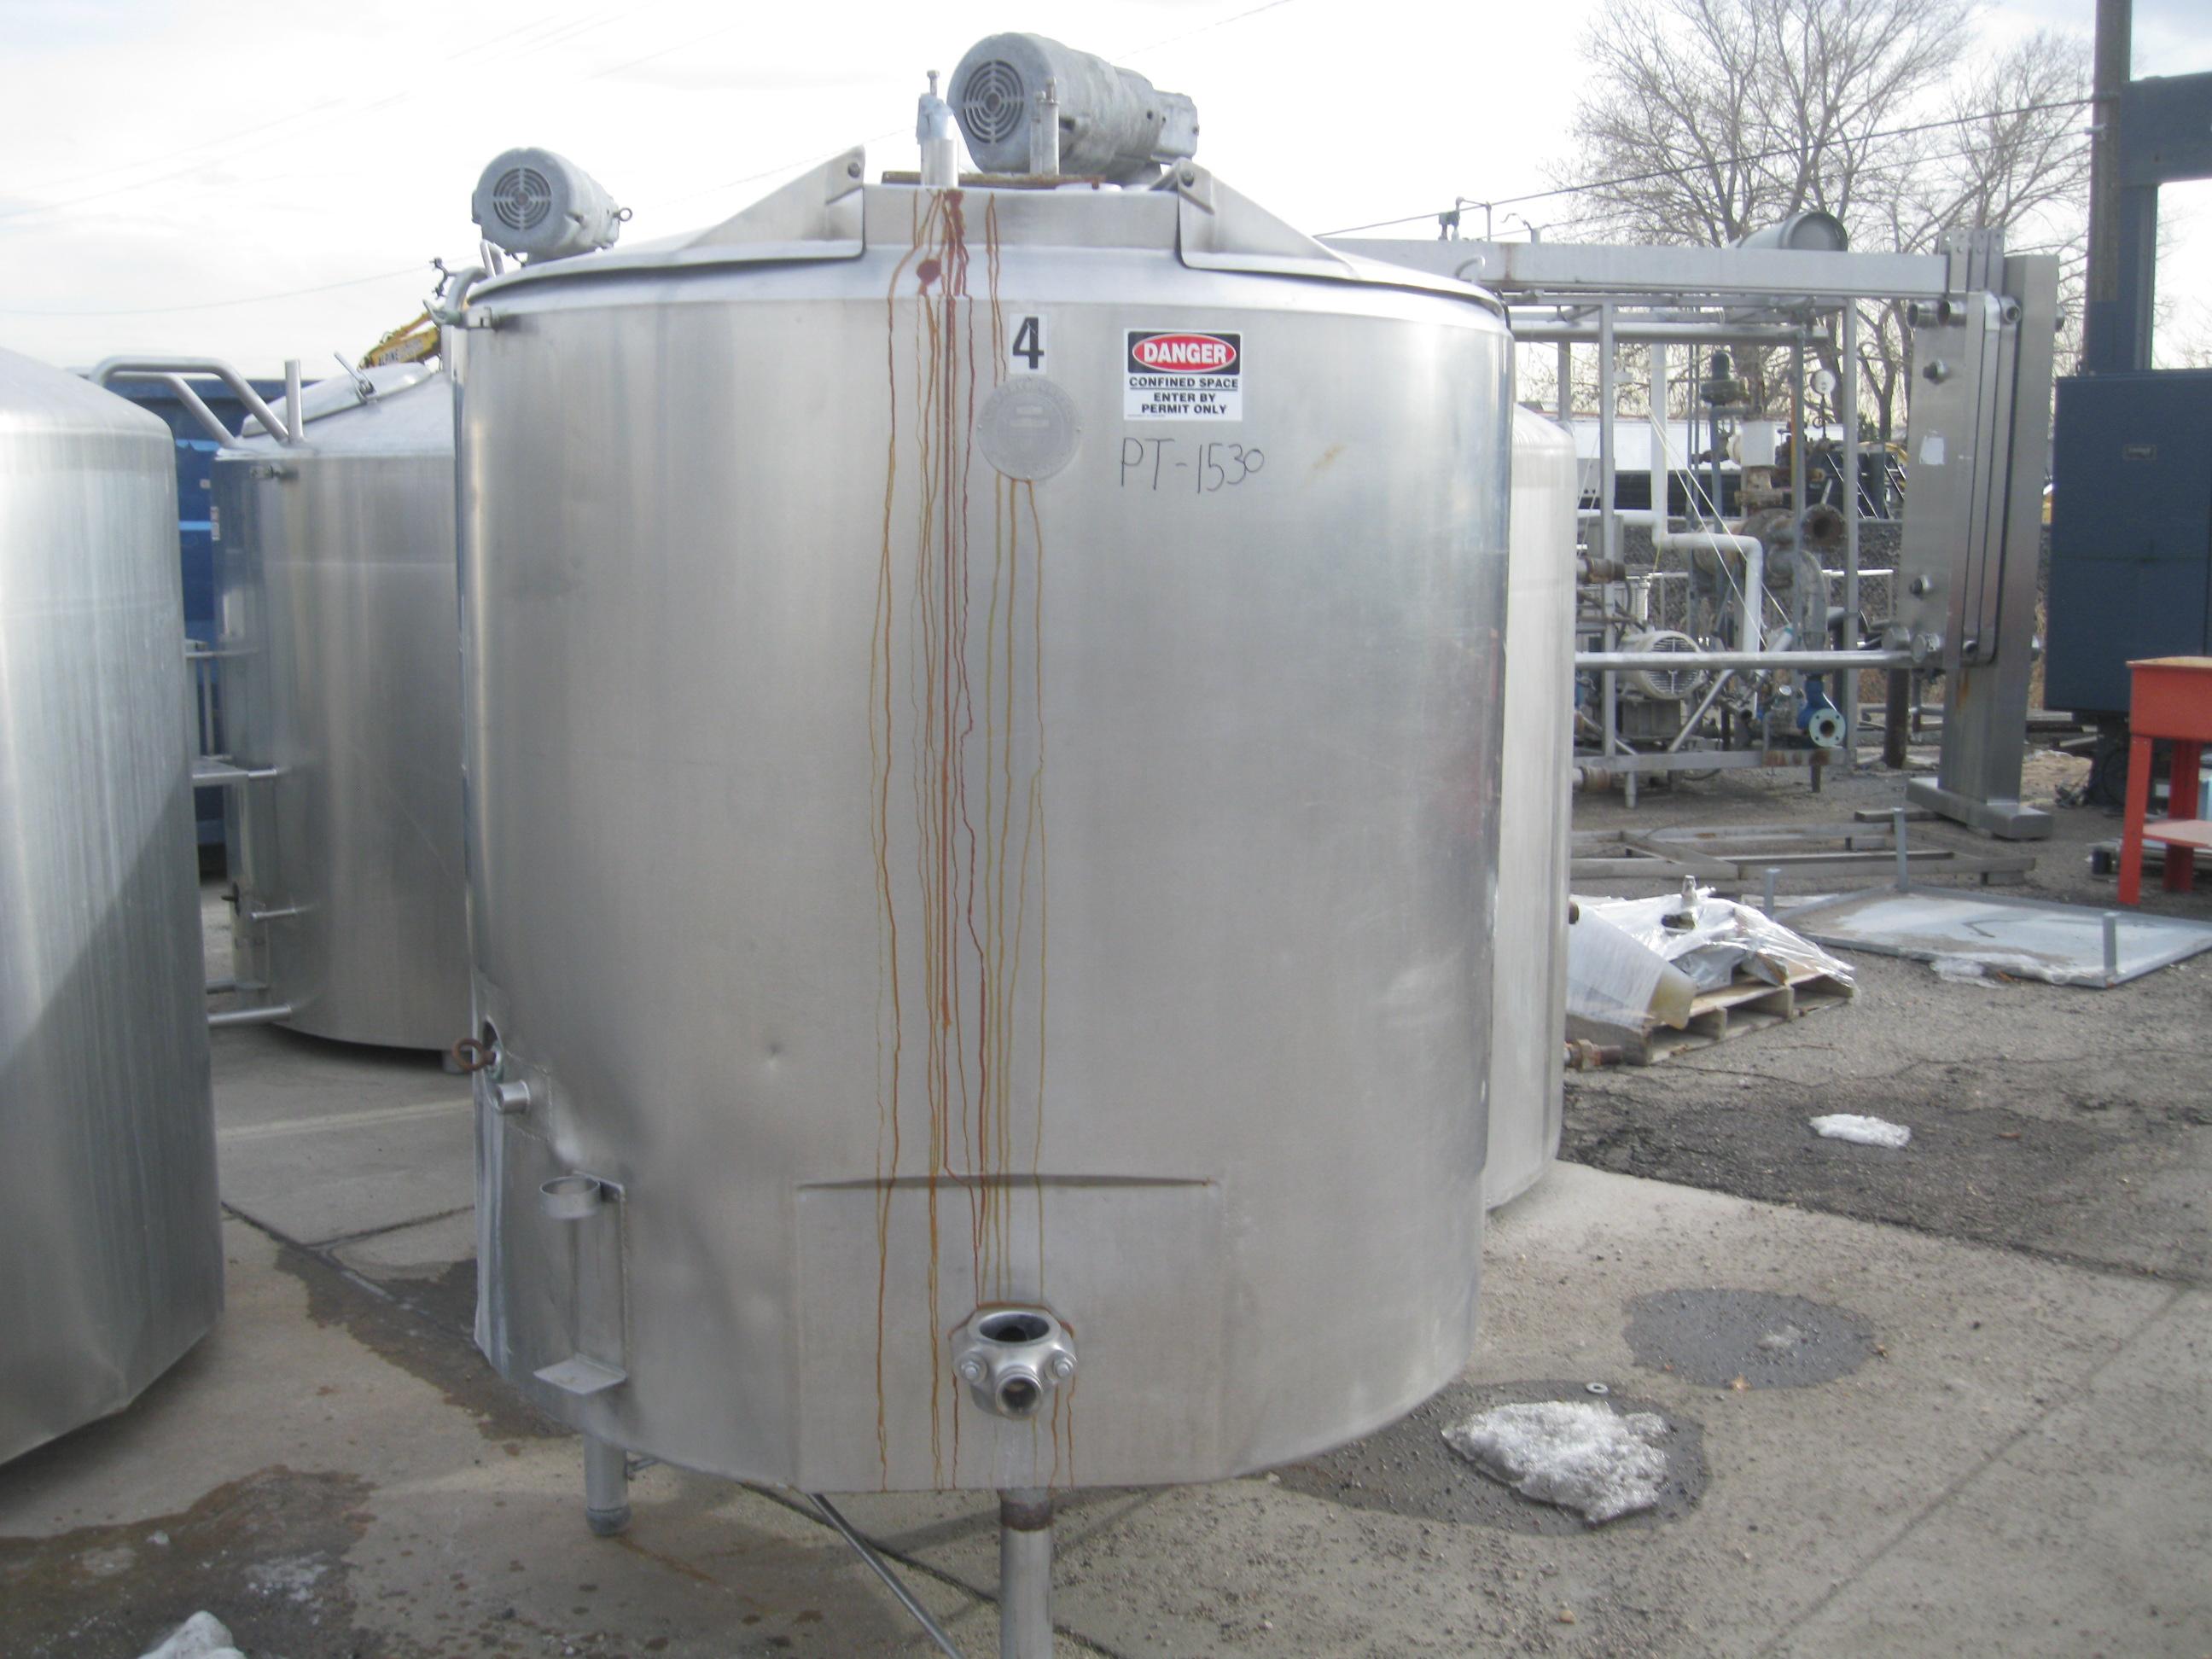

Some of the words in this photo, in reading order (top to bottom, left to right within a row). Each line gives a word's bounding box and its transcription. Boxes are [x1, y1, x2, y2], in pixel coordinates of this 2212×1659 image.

[1012, 317, 1045, 370] 4
[1144, 342, 1227, 364] DANGER
[1128, 377, 1196, 387] CONFINED
[1199, 378, 1239, 388] SPACE
[1153, 393, 1196, 403] ENTER
[1199, 393, 1216, 403] BY
[1141, 404, 1190, 414] PERMIT
[1193, 405, 1227, 415] ONLY
[1121, 437, 1265, 494] PT-1530
